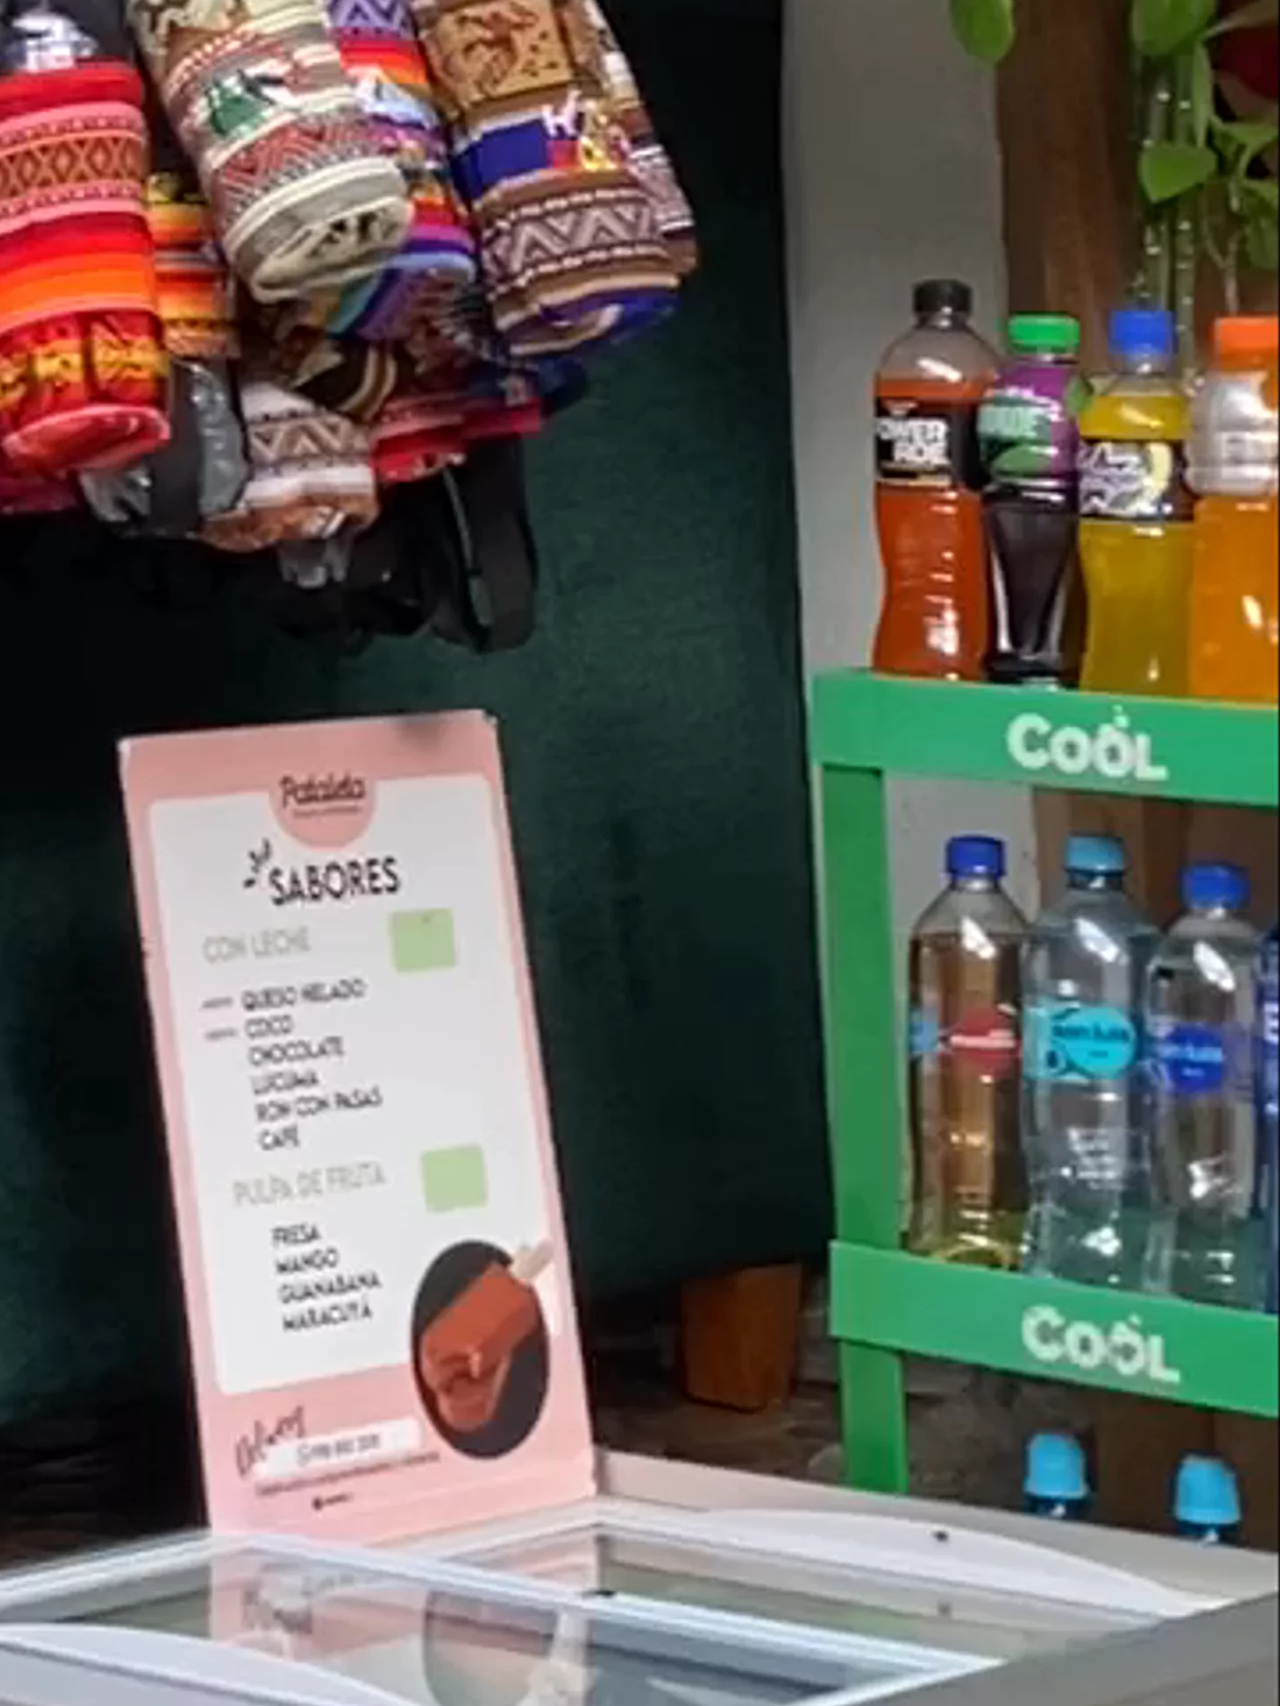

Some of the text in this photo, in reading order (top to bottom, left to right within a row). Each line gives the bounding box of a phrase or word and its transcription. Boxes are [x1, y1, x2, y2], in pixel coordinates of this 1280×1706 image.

[1006, 704, 1169, 782] COOL
[269, 856, 401, 906] SABORES
[203, 927, 311, 963] CON LECHE
[241, 978, 366, 1011] QUESO HELADO
[245, 1014, 293, 1039] COCO
[248, 1036, 344, 1065] CHOCOLATE
[255, 1084, 382, 1123] RON CON PASAS
[296, 1169, 323, 1198] DE
[325, 1161, 386, 1191] FRUTA
[271, 1223, 321, 1247] FRESA
[275, 1249, 339, 1275] MANGO
[1021, 1302, 1180, 1388] COOL
